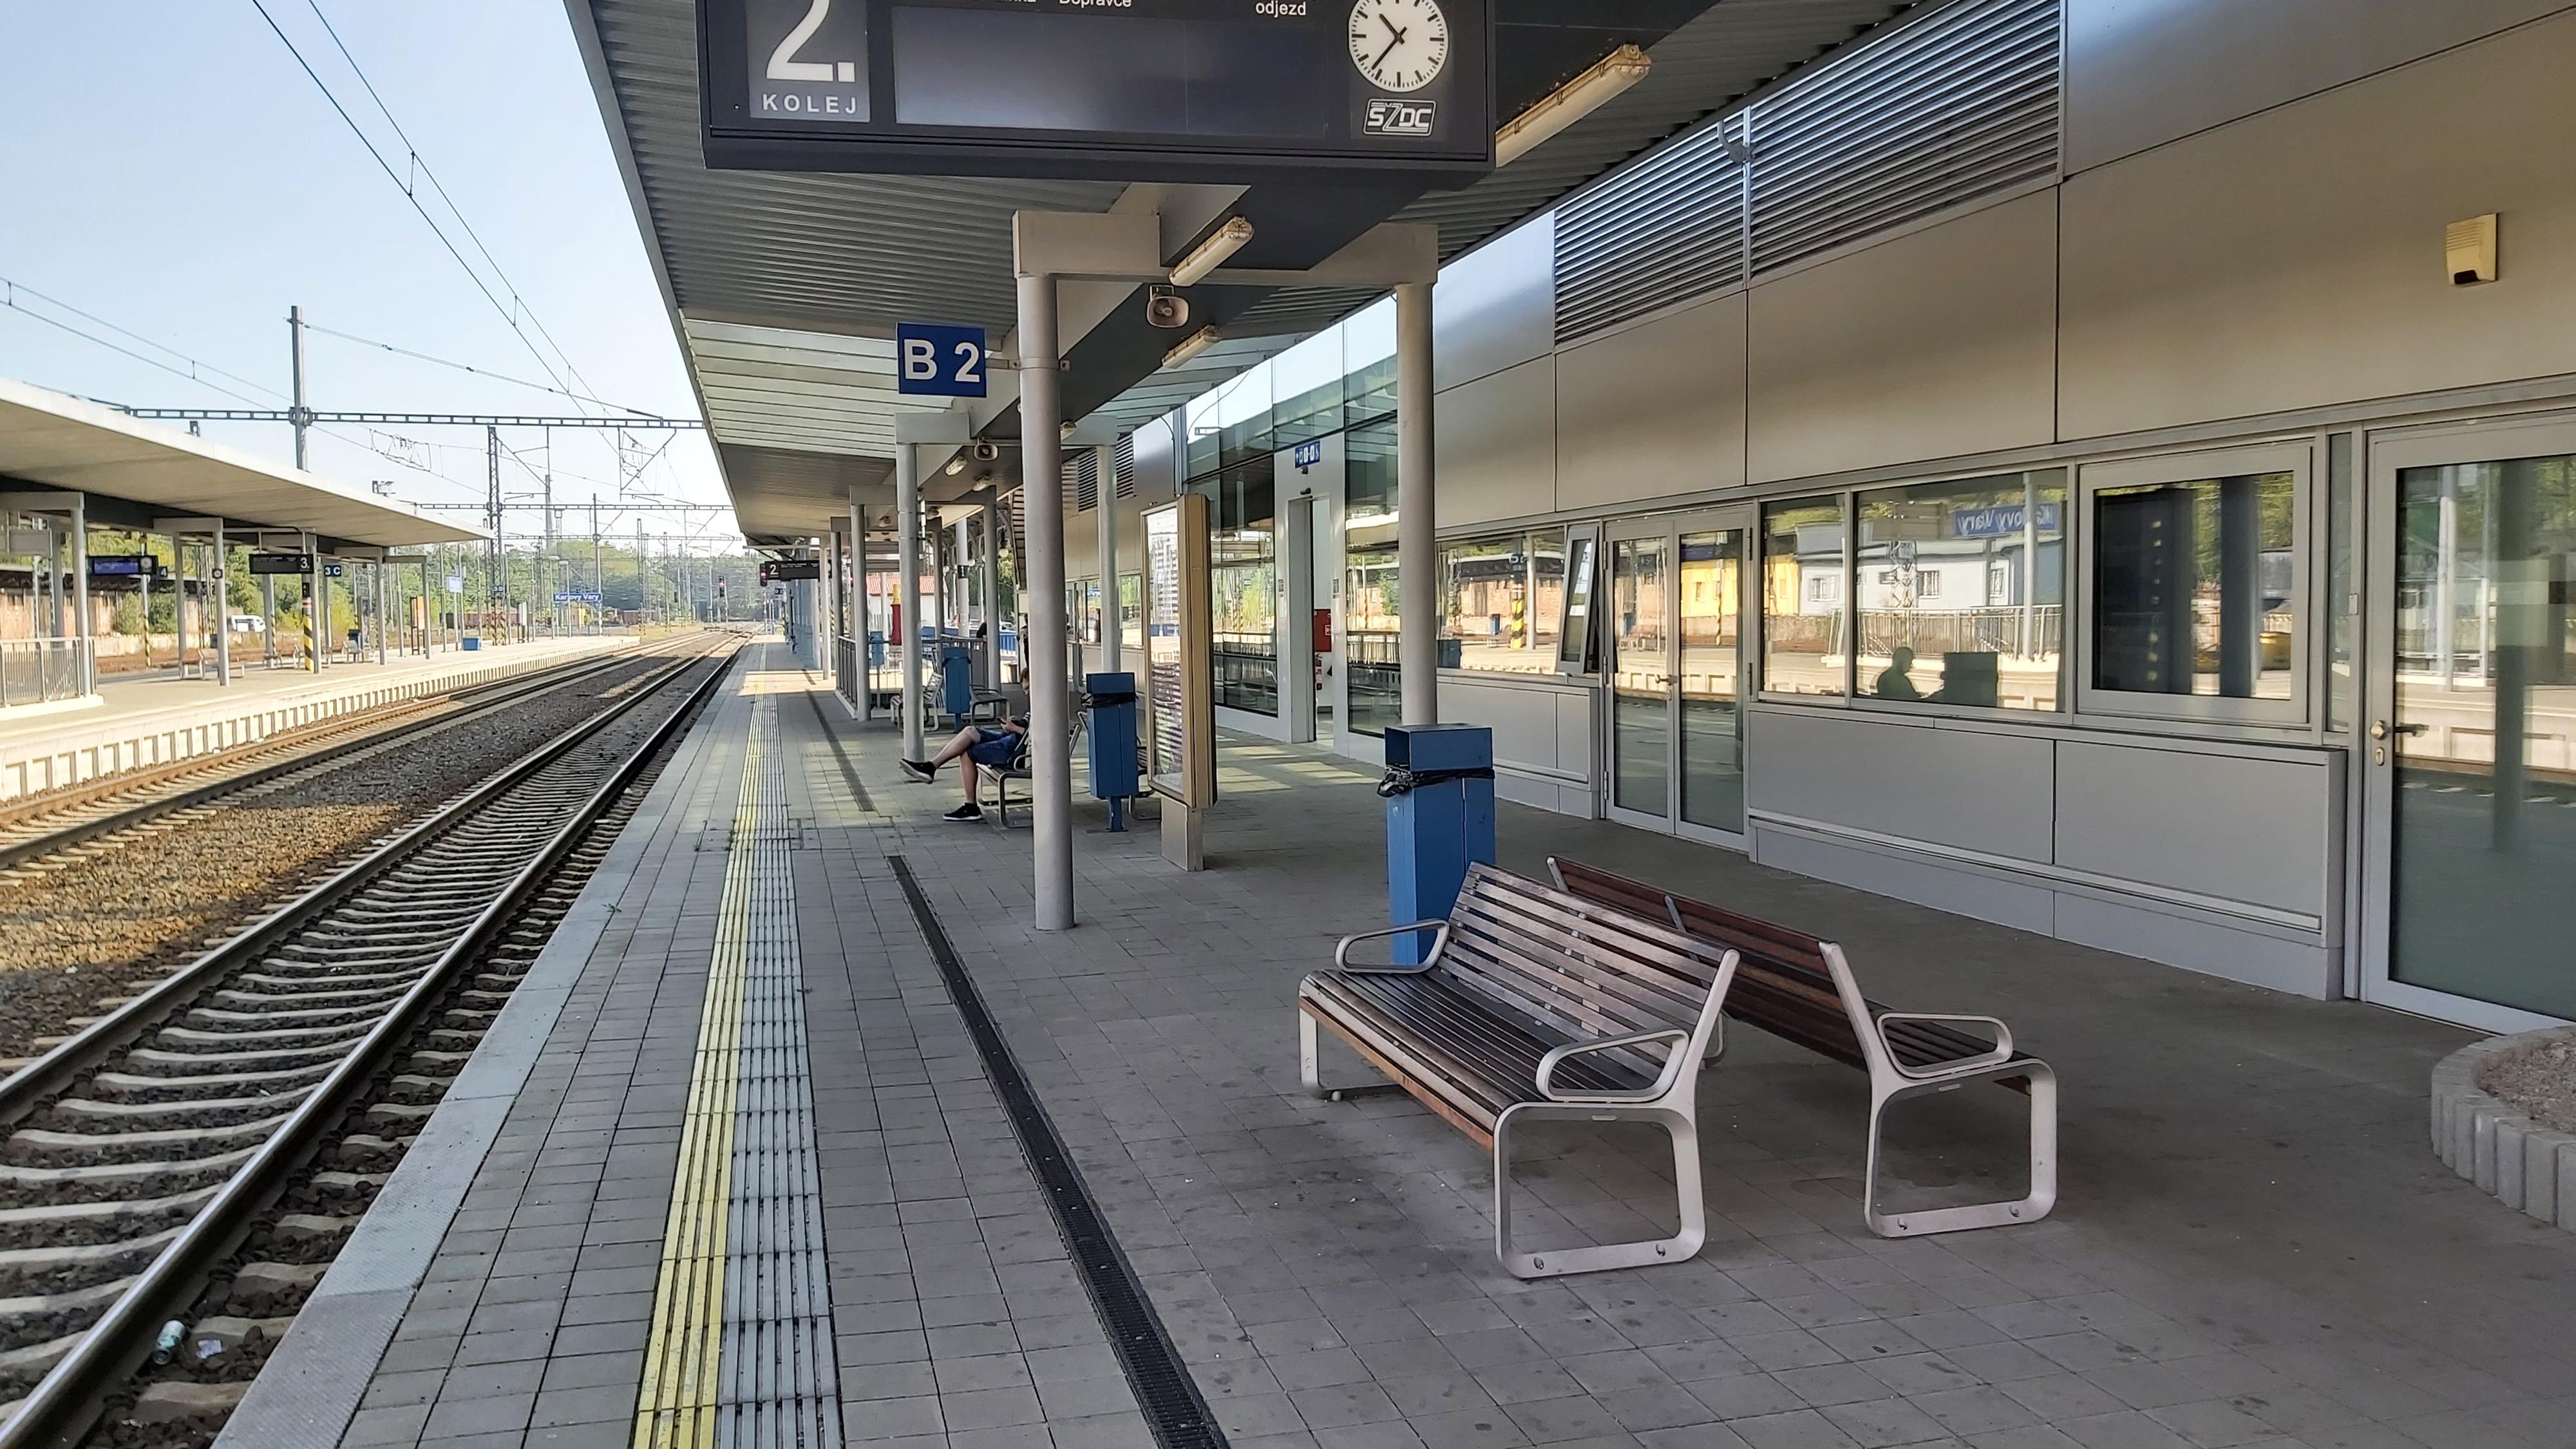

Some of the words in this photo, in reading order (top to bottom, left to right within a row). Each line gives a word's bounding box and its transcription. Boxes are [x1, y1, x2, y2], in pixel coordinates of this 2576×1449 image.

[1255, 0, 1307, 17] odjezd
[766, 0, 855, 82] 2.
[762, 93, 857, 115] KOLEJ
[904, 339, 938, 380] B
[954, 342, 980, 383] 2
[325, 567, 331, 575] 3
[555, 594, 582, 602] Karovy
[583, 593, 599, 601] Vary
